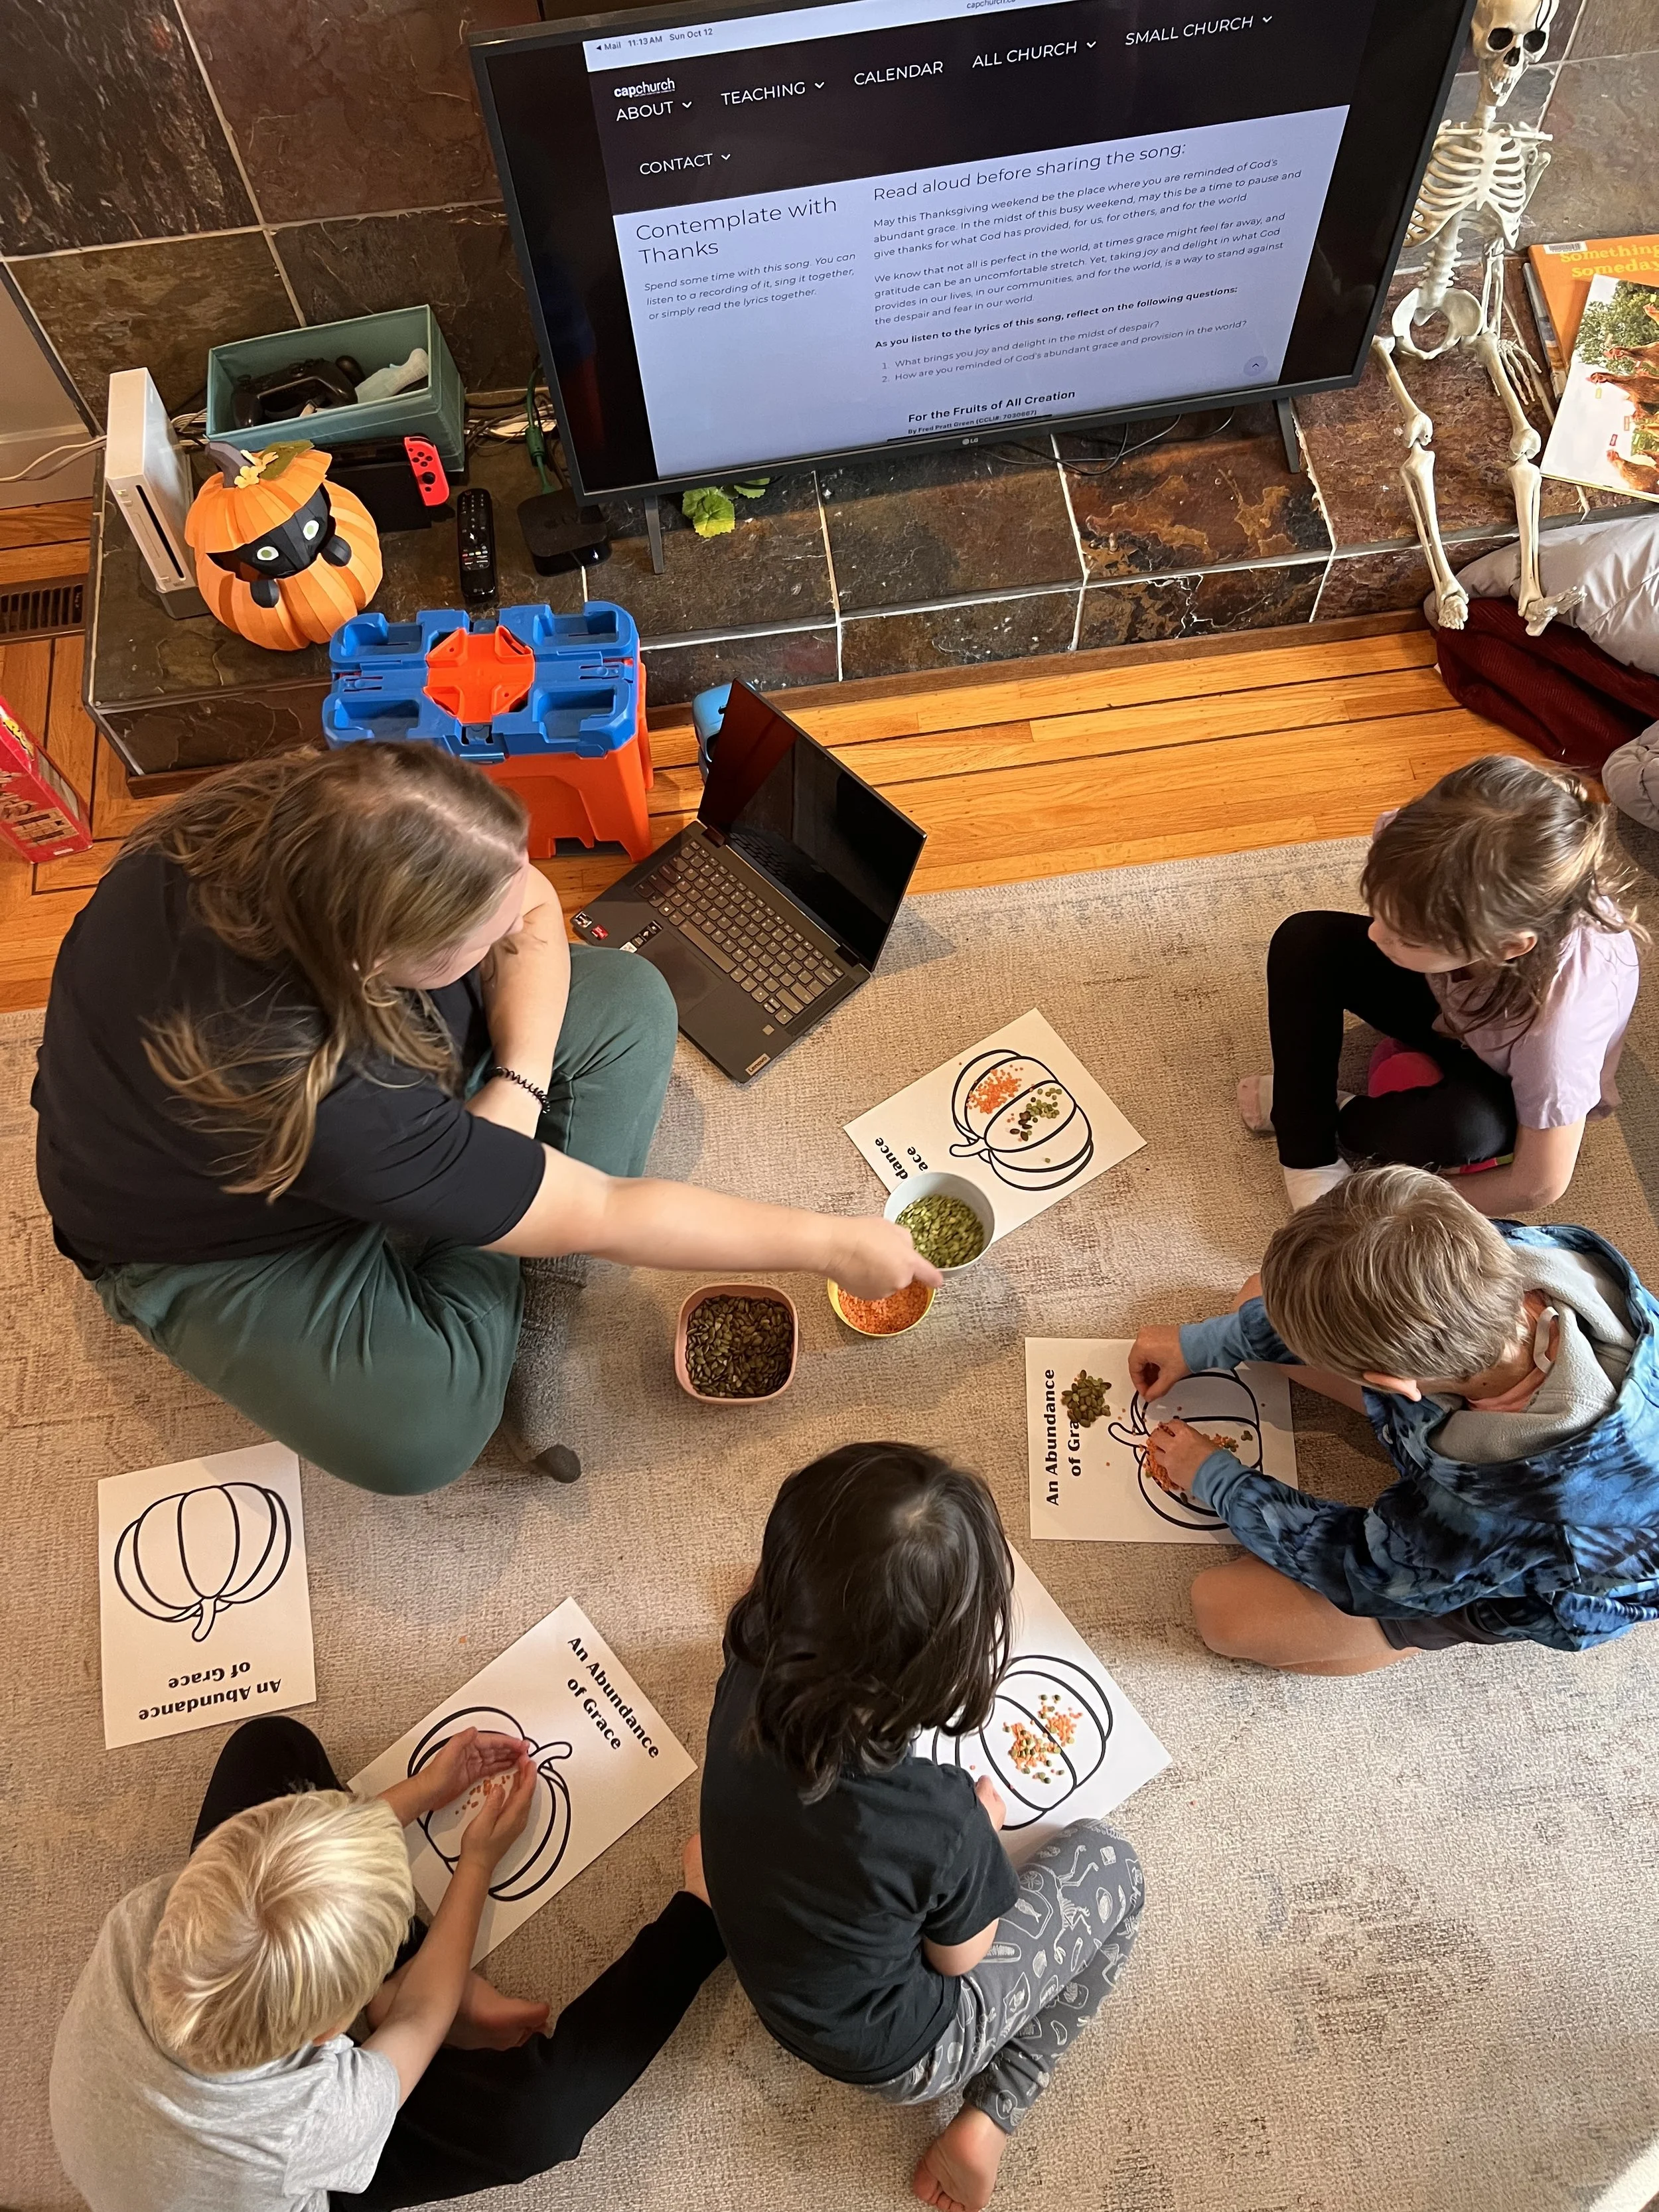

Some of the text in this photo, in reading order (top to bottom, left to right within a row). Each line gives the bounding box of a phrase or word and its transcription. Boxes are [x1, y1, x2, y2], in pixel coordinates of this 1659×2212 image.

[604, 41, 622, 50] Mail
[669, 33, 685, 41] Sun
[1125, 15, 1254, 46] SMALL CHURCH
[972, 40, 1078, 68] ALL CHURCH
[613, 77, 676, 99] capchurch
[853, 61, 944, 85] CALENDAR
[616, 101, 674, 121] ABOUT
[721, 81, 806, 106] TEACHING
[640, 153, 713, 175] CONTACT
[874, 144, 1186, 201] Read aloud before sharing the song:
[873, 229, 924, 243] abundant
[973, 219, 991, 228] the
[993, 214, 1022, 224] midst
[1025, 210, 1036, 220] of
[1038, 208, 1057, 218] this
[1060, 205, 1084, 214] busy
[1086, 195, 1135, 210] weekend,
[1138, 193, 1161, 202] may
[1163, 190, 1182, 198] this
[1209, 182, 1232, 191] time
[1248, 175, 1279, 187] pause
[1281, 170, 1302, 180] and
[874, 218, 895, 228] May
[897, 214, 916, 224] this
[919, 204, 988, 220] Thanksgiving
[991, 194, 1039, 209] weekend
[1057, 190, 1075, 200] the
[1077, 186, 1106, 198] place
[1108, 181, 1141, 192] where
[1141, 178, 1162, 188] you
[1183, 164, 1234, 180] reminded
[1236, 162, 1248, 172] of
[1249, 159, 1277, 170] God's
[636, 196, 836, 240] Contemplate with
[638, 240, 718, 264] Thanks
[894, 271, 921, 280] know
[924, 267, 944, 275] that
[947, 263, 964, 272] not
[966, 260, 977, 269] all
[990, 254, 1026, 267] perfect
[1060, 243, 1090, 254] world,
[1106, 238, 1134, 248] times
[1136, 233, 1164, 244] grace
[1166, 227, 1197, 238] might
[1200, 222, 1218, 233] feel
[1236, 218, 1262, 227] away,
[1265, 212, 1285, 223] and
[644, 279, 678, 292] Spend
[680, 276, 709, 286] some
[711, 272, 735, 281] time
[737, 267, 760, 277] with
[763, 263, 782, 273] this
[815, 257, 833, 265] You
[836, 254, 855, 262] can
[646, 296, 674, 306] listen
[699, 285, 748, 298] recording
[751, 281, 761, 290] of
[774, 277, 796, 287] sing
[808, 269, 854, 281] together,
[875, 299, 916, 313] provides
[950, 291, 973, 300] lives,
[1007, 275, 1074, 291] communities,
[1076, 270, 1096, 281] and
[1133, 260, 1162, 271] world,
[1217, 247, 1246, 259] stand
[1247, 242, 1283, 255] against
[661, 307, 695, 318] simply
[697, 302, 721, 313] read
[723, 300, 741, 309] the
[743, 296, 768, 307] lyrics
[890, 338, 908, 347] you
[911, 333, 938, 342] listen
[974, 324, 1000, 334] lyrics
[1003, 320, 1013, 329] of
[1015, 317, 1034, 327] this
[1037, 315, 1064, 323] song,
[1066, 308, 1099, 319] reflect
[1137, 295, 1183, 308] following
[1186, 287, 1238, 301] questions:
[908, 391, 1075, 423] For the Fruits of All Creation
[875, 1138, 908, 1179] dance
[907, 1146, 928, 1171] ace
[1043, 1369, 1059, 1506] An Abundance
[1067, 1420, 1082, 1477] of Gra
[169, 1662, 251, 1688] of Grace
[138, 1678, 281, 1720] An Abundance
[567, 1637, 659, 1759] An Abundance
[567, 1678, 621, 1750] of Grace
